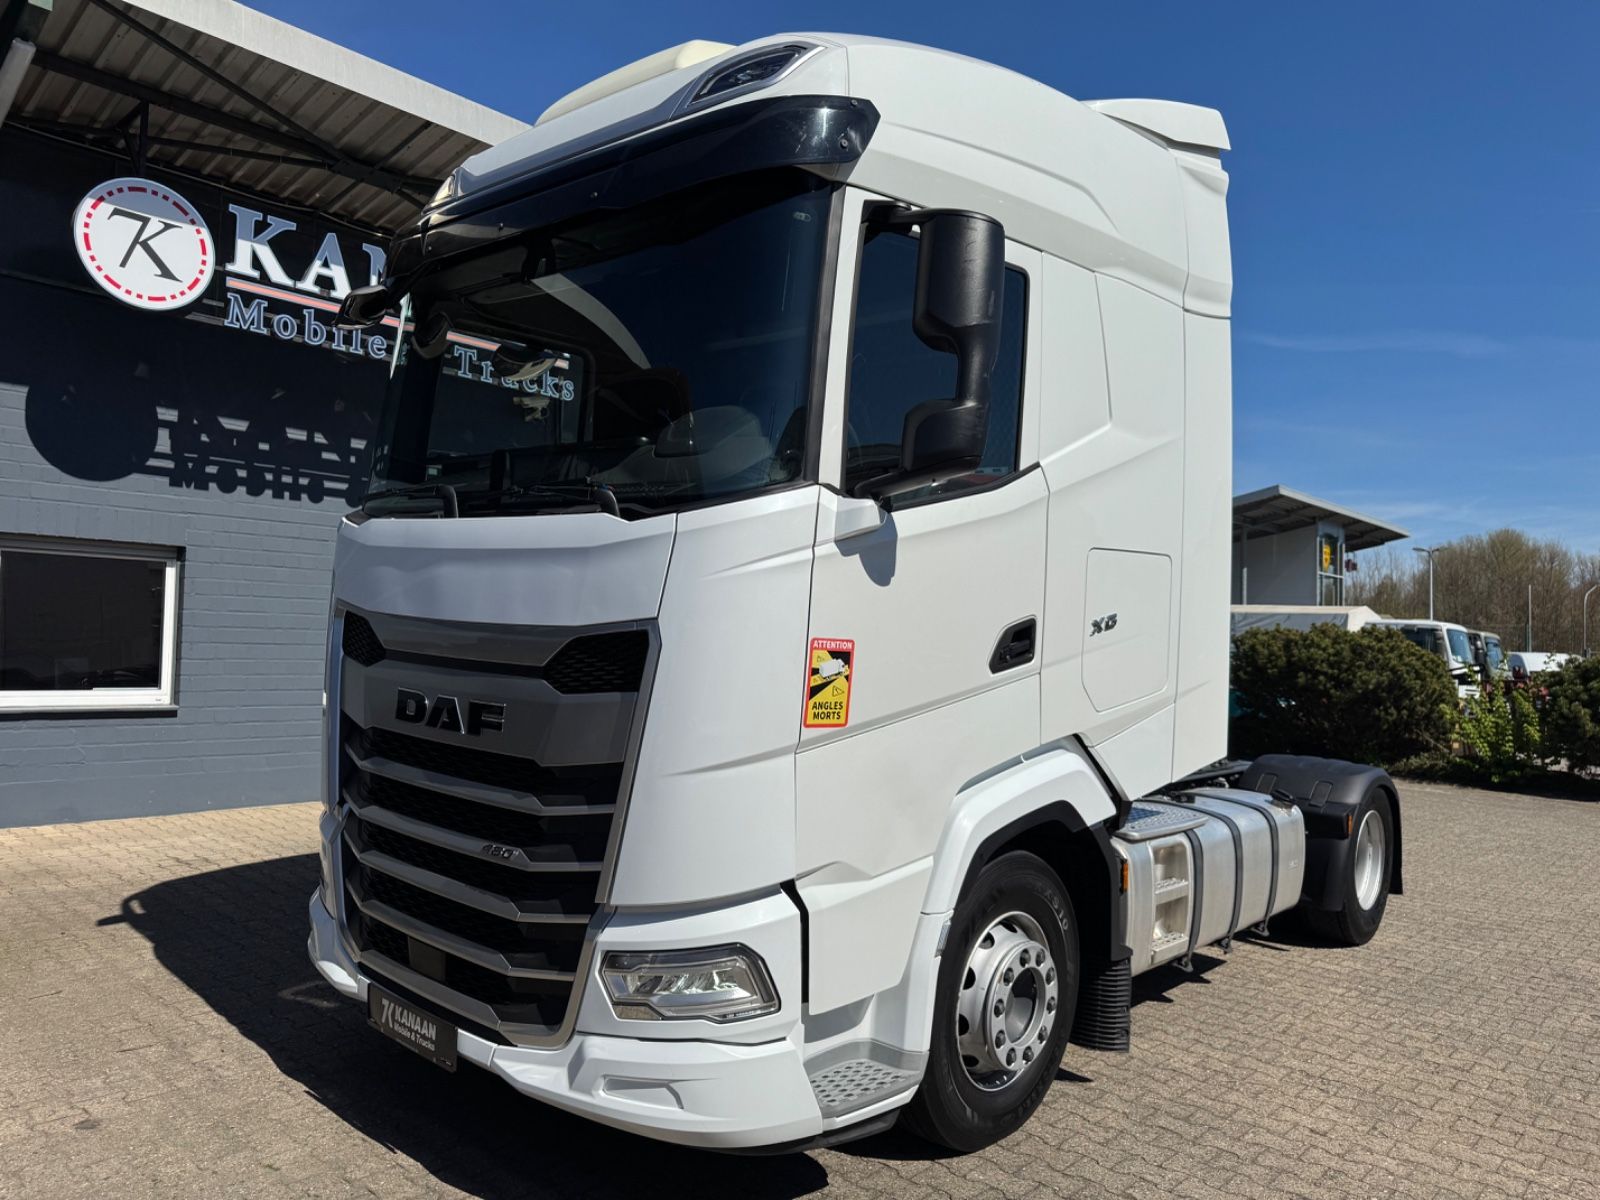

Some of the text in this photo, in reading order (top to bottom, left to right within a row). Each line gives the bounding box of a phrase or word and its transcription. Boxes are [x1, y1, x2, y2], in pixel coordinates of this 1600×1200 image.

[812, 639, 853, 650] ATTENTION
[812, 700, 843, 711] ANGLES
[395, 687, 507, 737] DAF
[812, 710, 841, 720] MORTS
[394, 1004, 437, 1041] KANAAN
